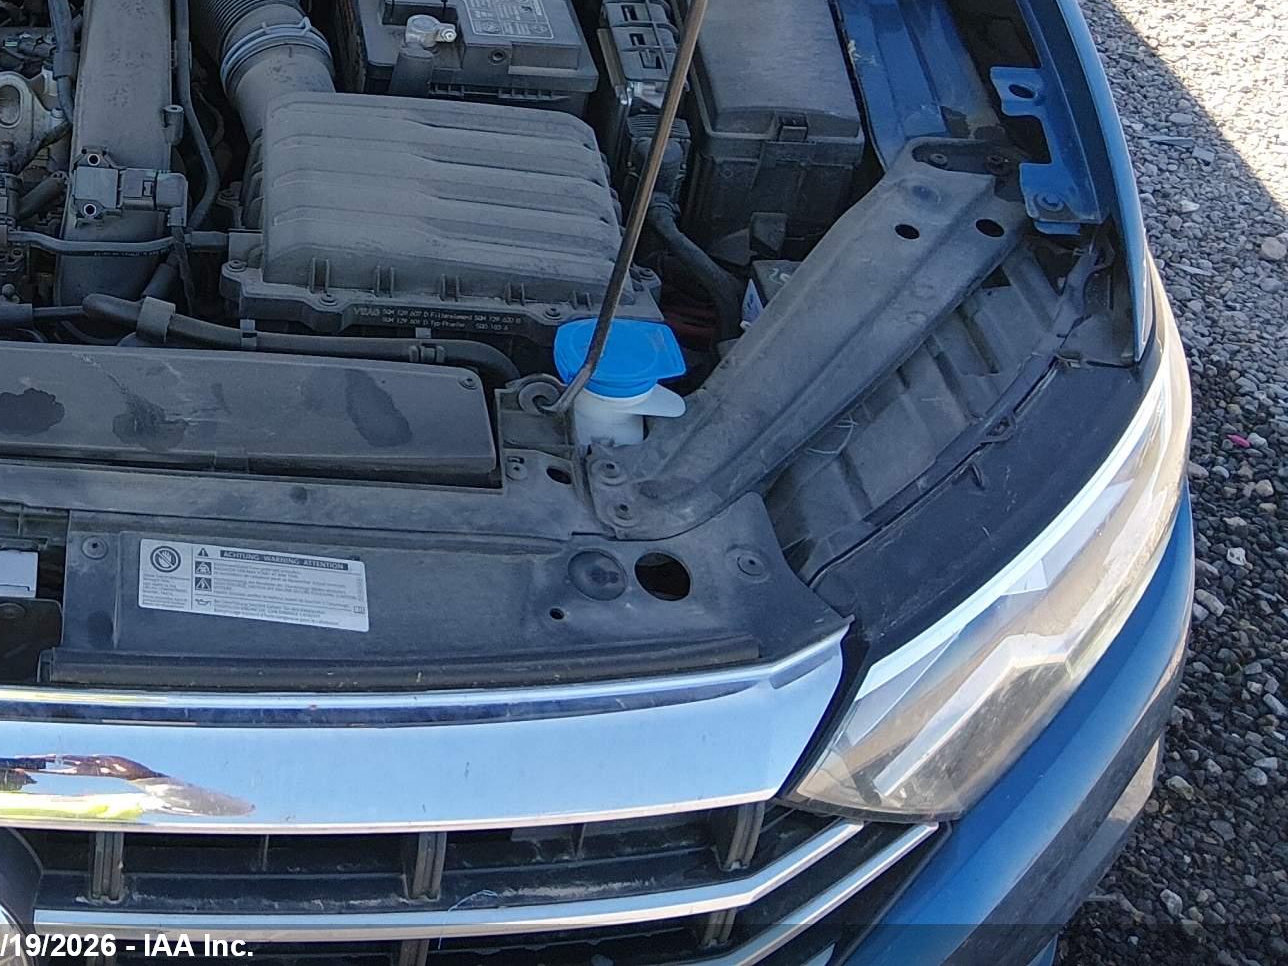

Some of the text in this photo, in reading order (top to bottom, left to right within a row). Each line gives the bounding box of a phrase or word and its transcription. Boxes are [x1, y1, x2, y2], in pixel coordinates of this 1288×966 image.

[223, 550, 260, 561] ACHTUNG
[263, 554, 300, 565] WARNING
[303, 559, 344, 570] ATTENTION
